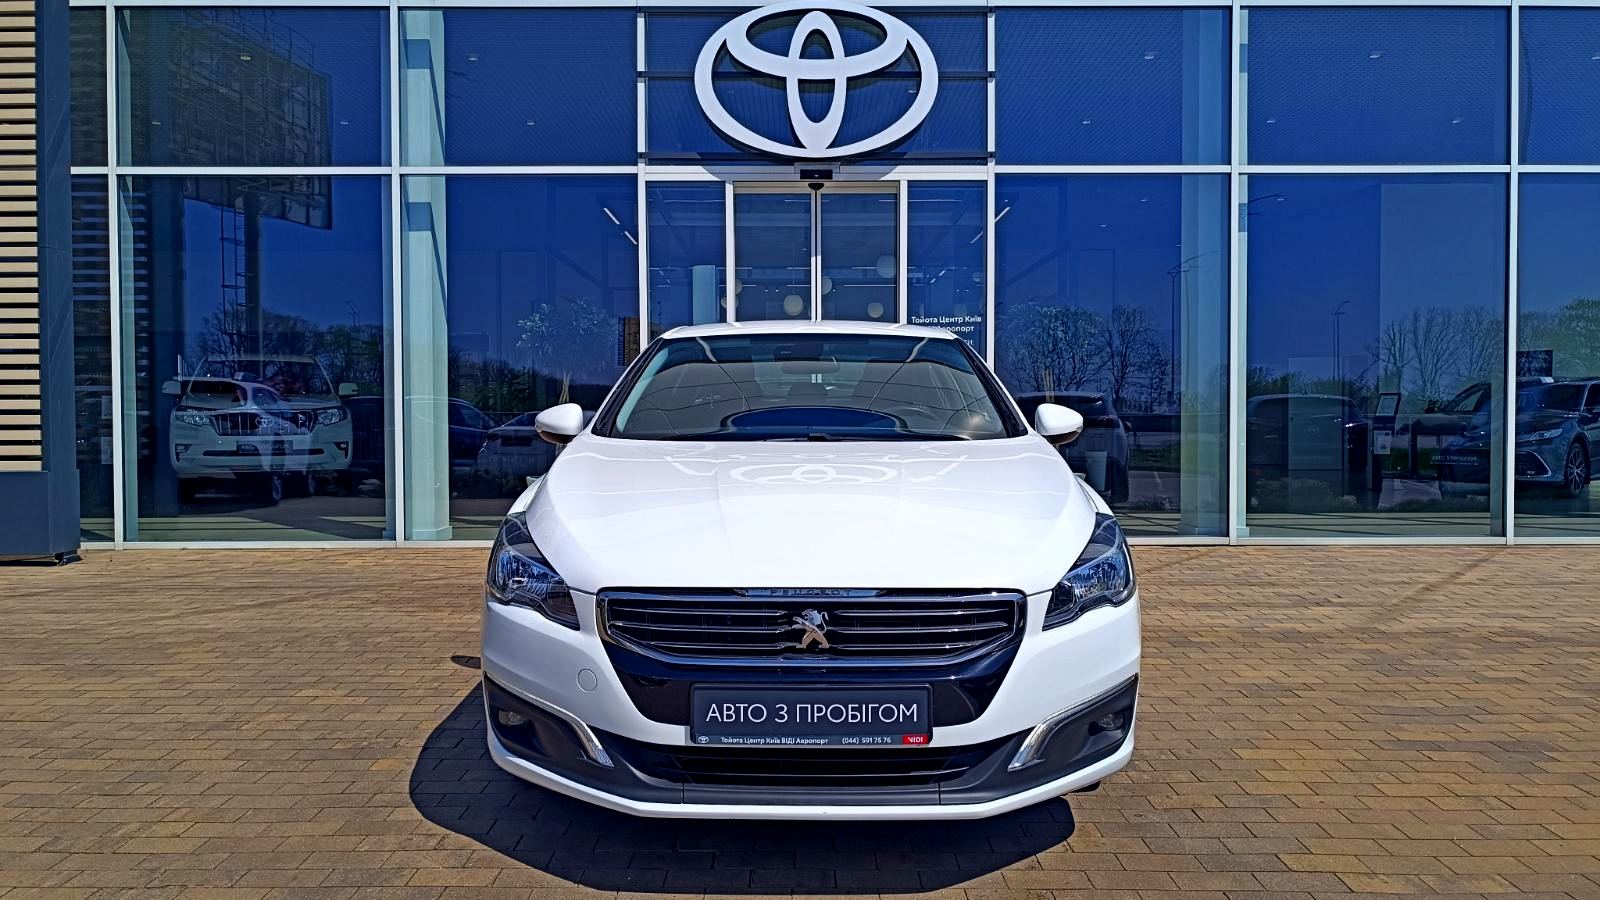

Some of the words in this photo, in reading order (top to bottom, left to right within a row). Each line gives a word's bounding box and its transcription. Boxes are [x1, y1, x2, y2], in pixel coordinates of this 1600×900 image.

[939, 316, 964, 324] Центр
[770, 588, 852, 596] PEUGEOT
[705, 703, 768, 723] АВТО
[774, 703, 789, 723] З
[796, 703, 918, 723] ПРОБІГОМ
[744, 737, 765, 745] Центр
[766, 736, 780, 744] Київ
[781, 737, 795, 745] ВІДІ
[796, 737, 829, 745] Аеропорт
[841, 737, 860, 745] (044)
[908, 735, 924, 743] VIDI
